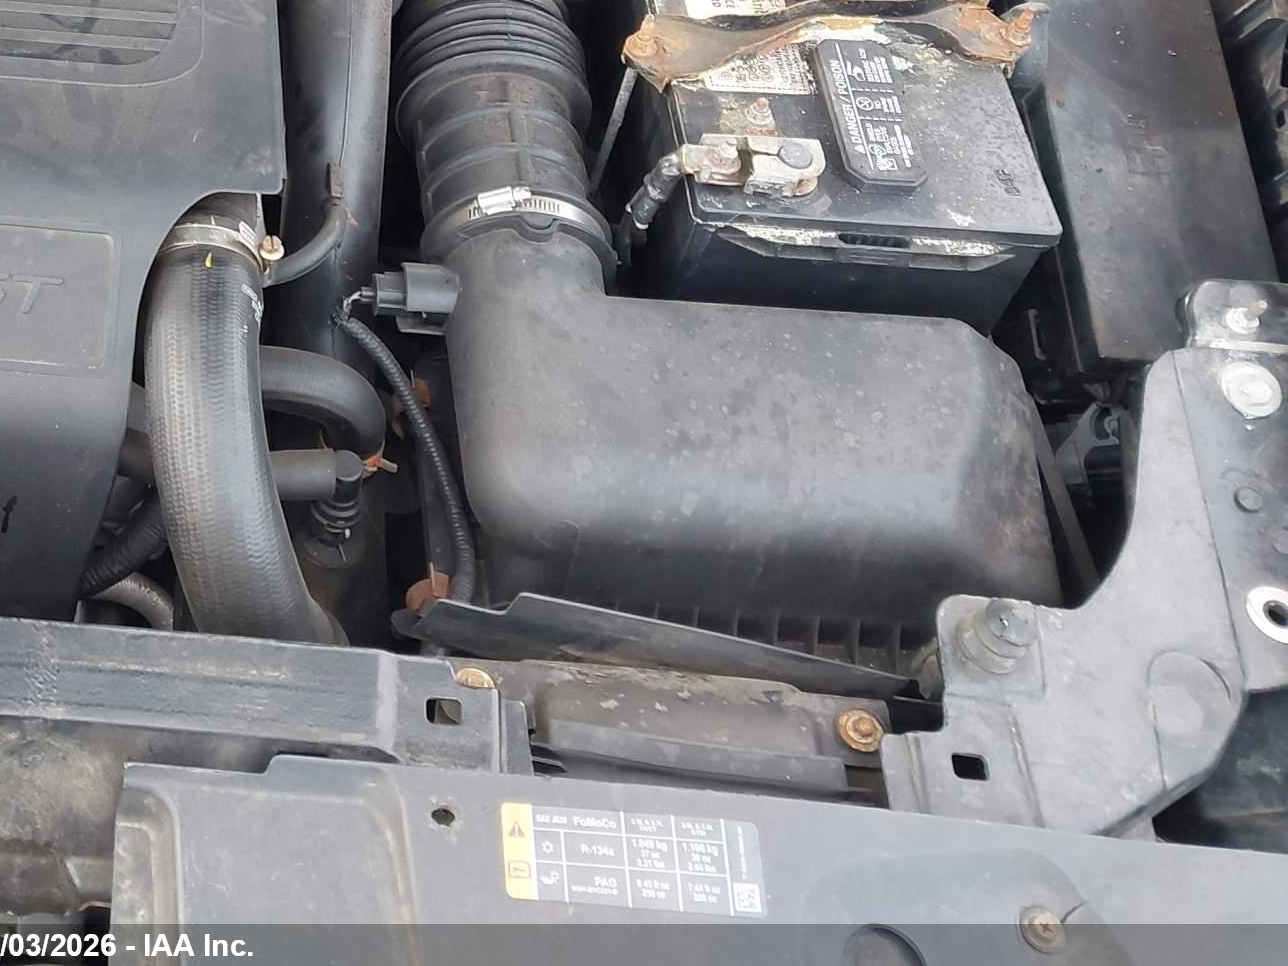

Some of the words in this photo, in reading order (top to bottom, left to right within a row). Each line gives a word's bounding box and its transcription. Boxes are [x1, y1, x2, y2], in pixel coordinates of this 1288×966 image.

[829, 59, 850, 95] POISON
[841, 103, 865, 144] DANGER
[573, 816, 617, 829] FoMoCo
[580, 843, 616, 856] R-134a
[594, 876, 617, 888] PAG
